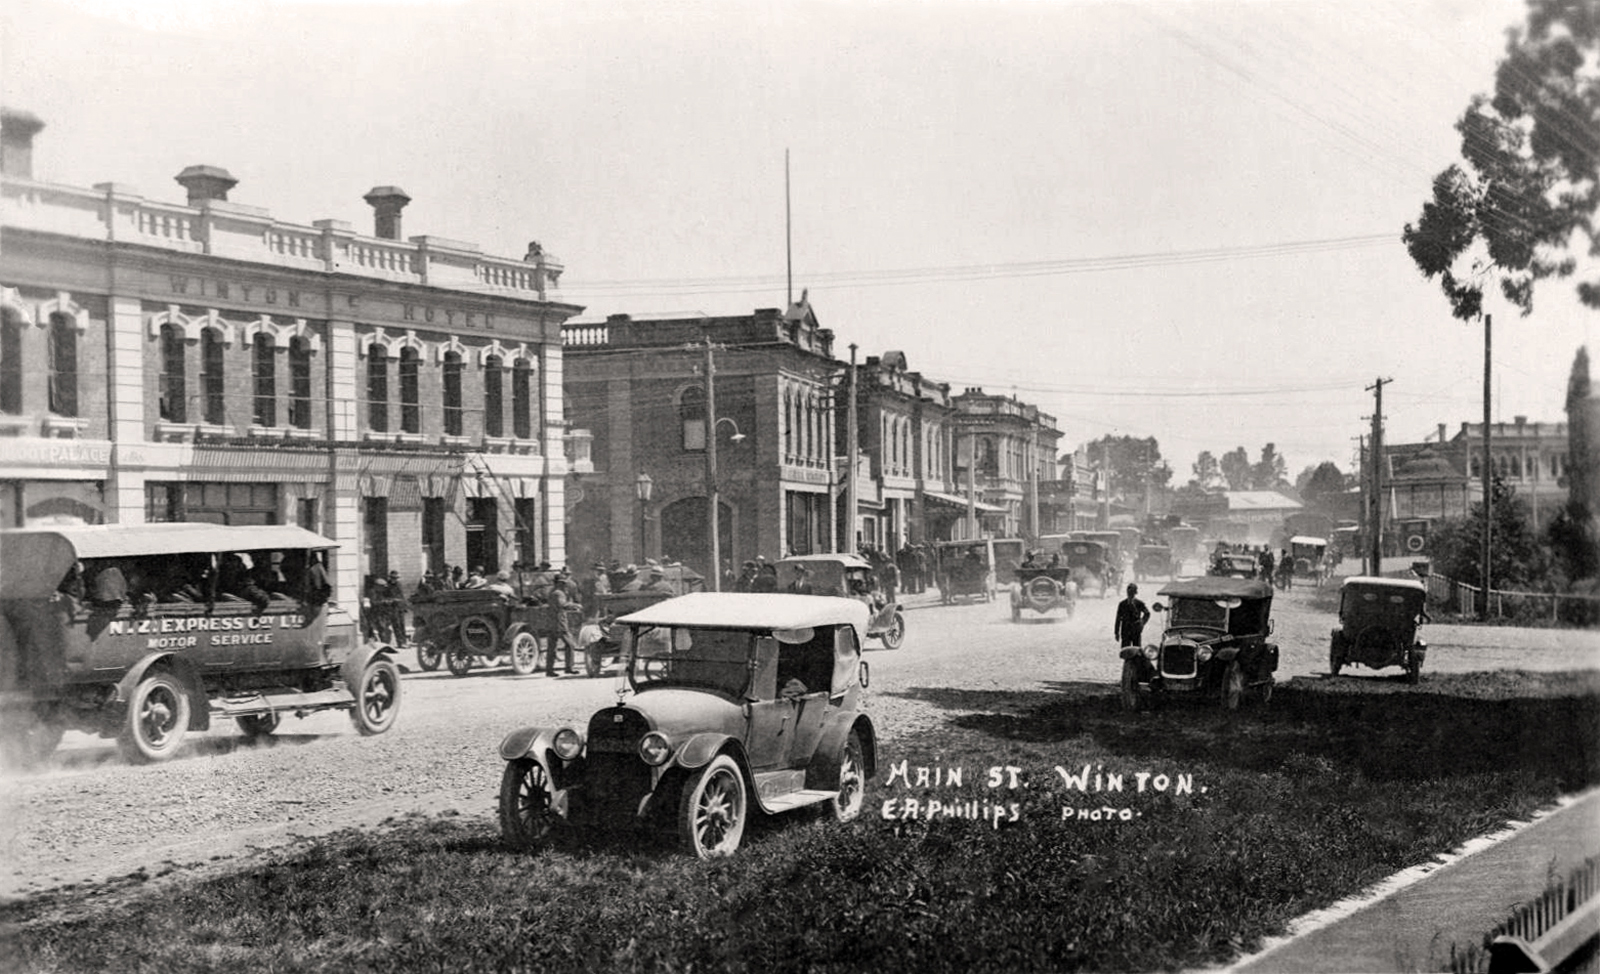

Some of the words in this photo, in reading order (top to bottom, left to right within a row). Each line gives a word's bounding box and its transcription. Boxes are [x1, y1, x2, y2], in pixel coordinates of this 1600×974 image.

[168, 274, 300, 307] WINTON
[161, 617, 244, 633] EXPRESS
[148, 636, 197, 649] MOTOR
[210, 633, 274, 647] SERVICE
